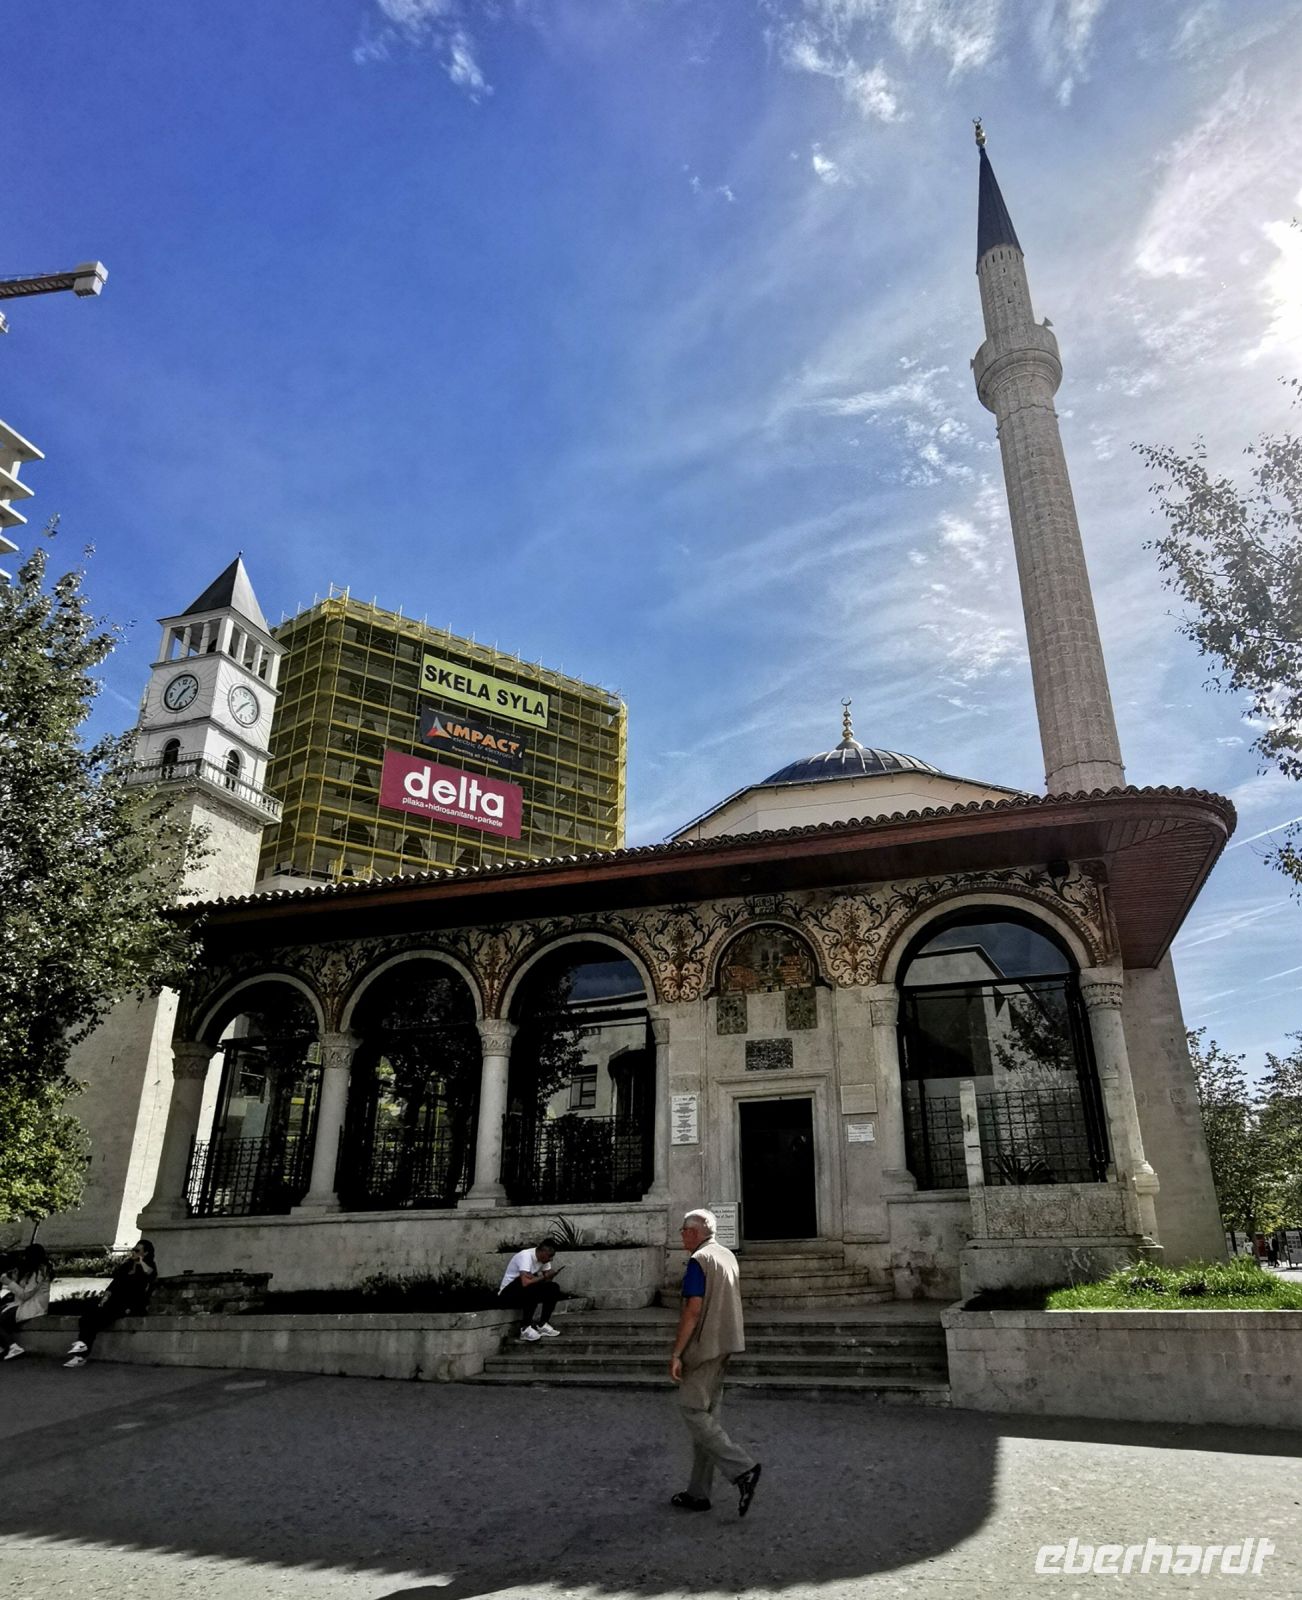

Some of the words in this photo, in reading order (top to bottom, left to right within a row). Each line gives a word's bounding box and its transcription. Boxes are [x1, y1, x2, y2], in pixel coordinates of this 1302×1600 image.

[424, 664, 490, 701] SKELA
[496, 689, 545, 718] SYLA
[446, 721, 520, 755] IMPACT
[404, 766, 504, 818] delta
